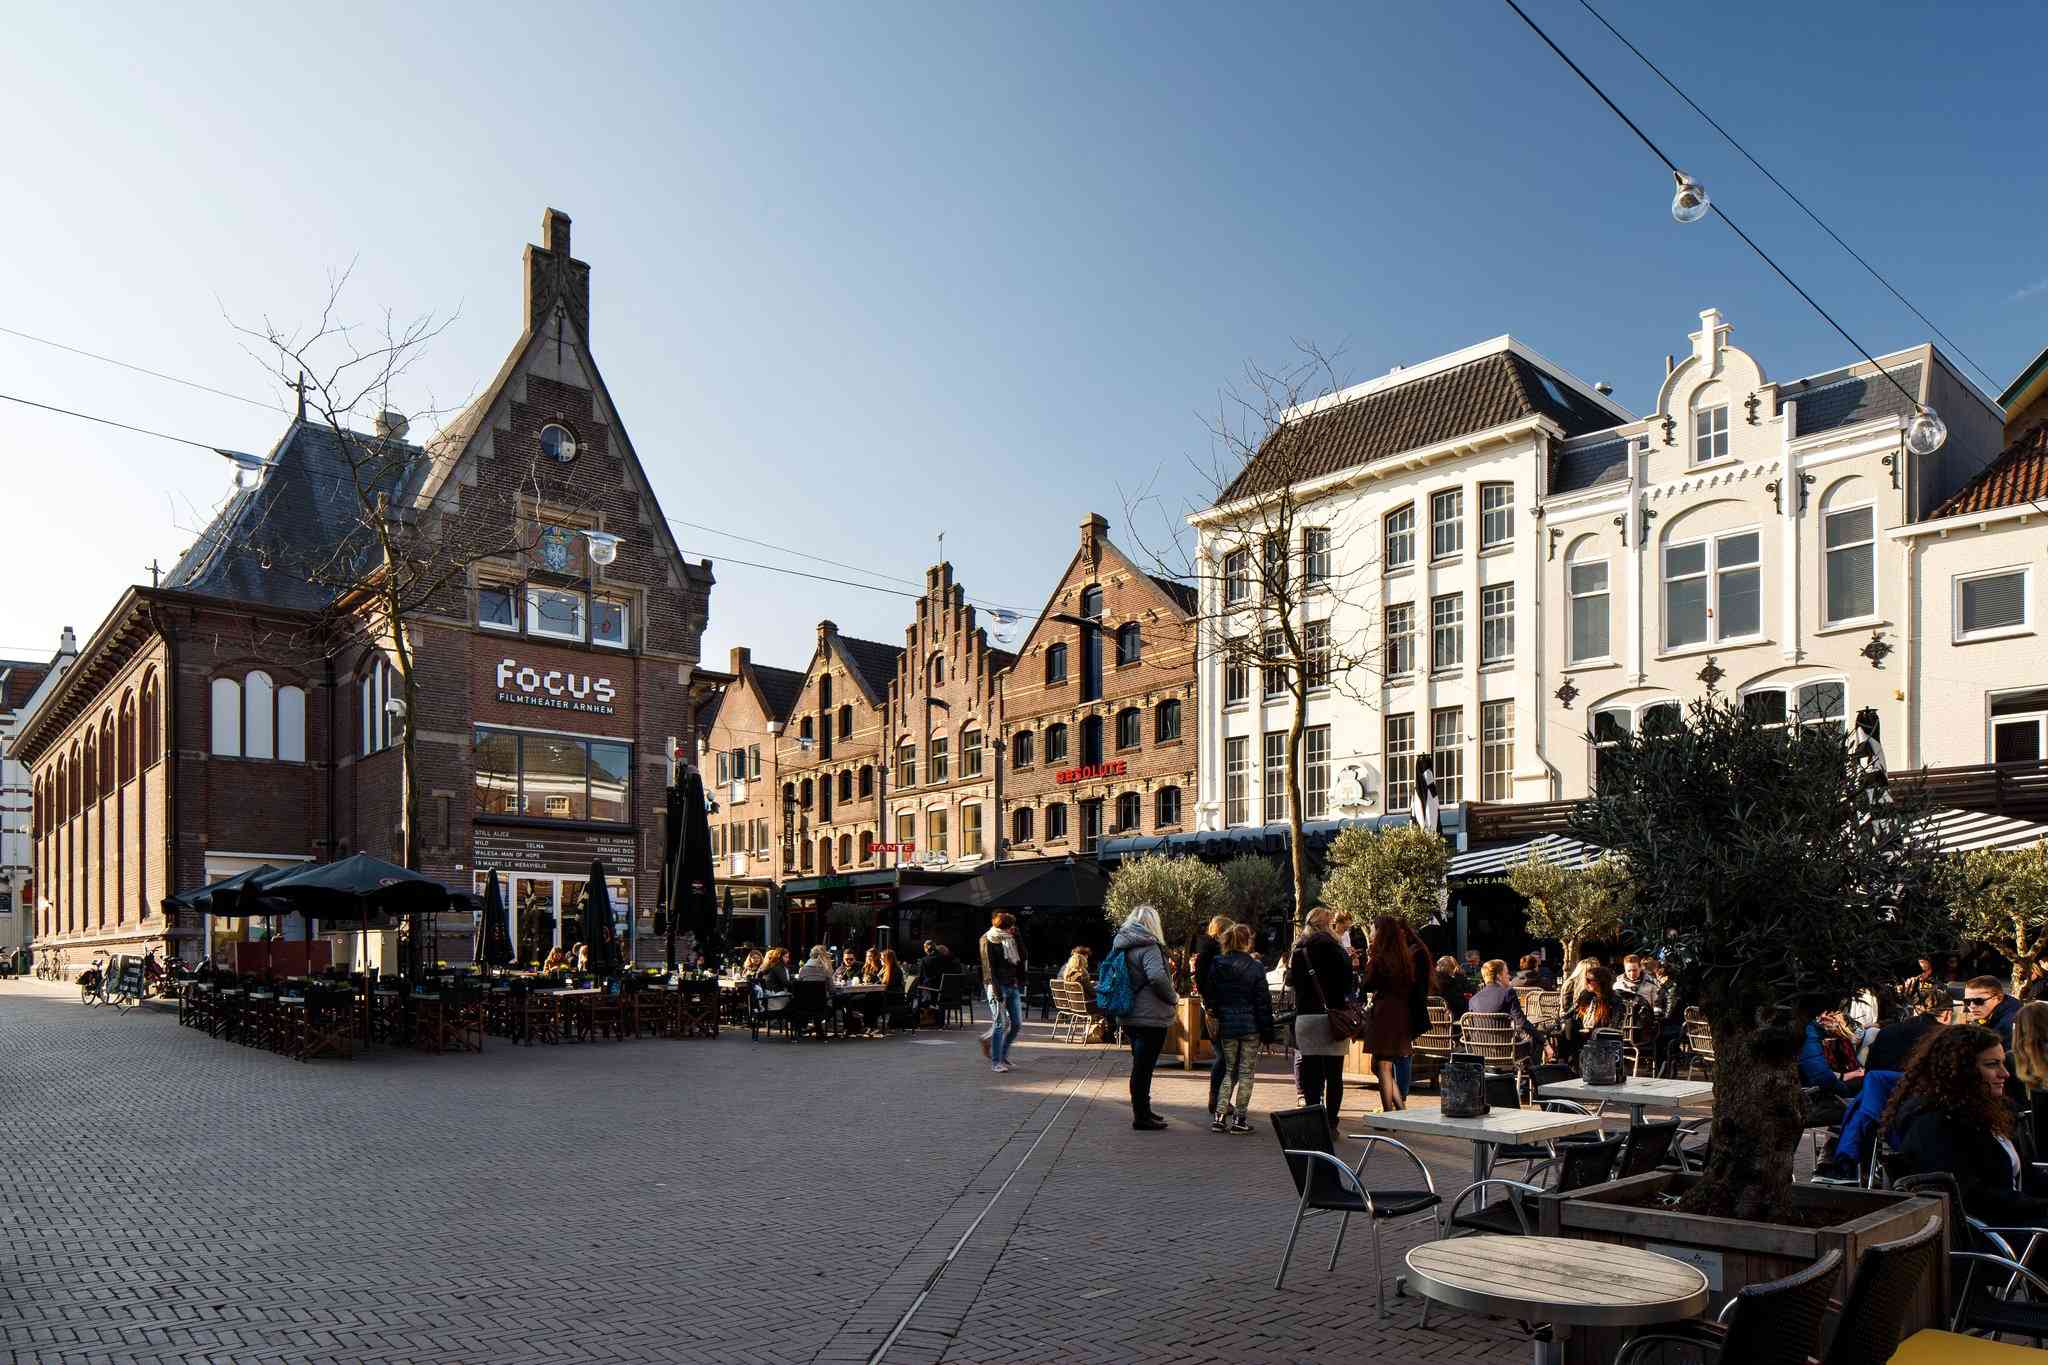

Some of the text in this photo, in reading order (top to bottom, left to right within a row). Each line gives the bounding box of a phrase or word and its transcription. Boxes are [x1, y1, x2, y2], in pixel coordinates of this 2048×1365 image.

[496, 658, 616, 703] FOCUS
[499, 692, 614, 714] FILMTHEATER ARNHEM
[871, 843, 913, 852] TANTE
